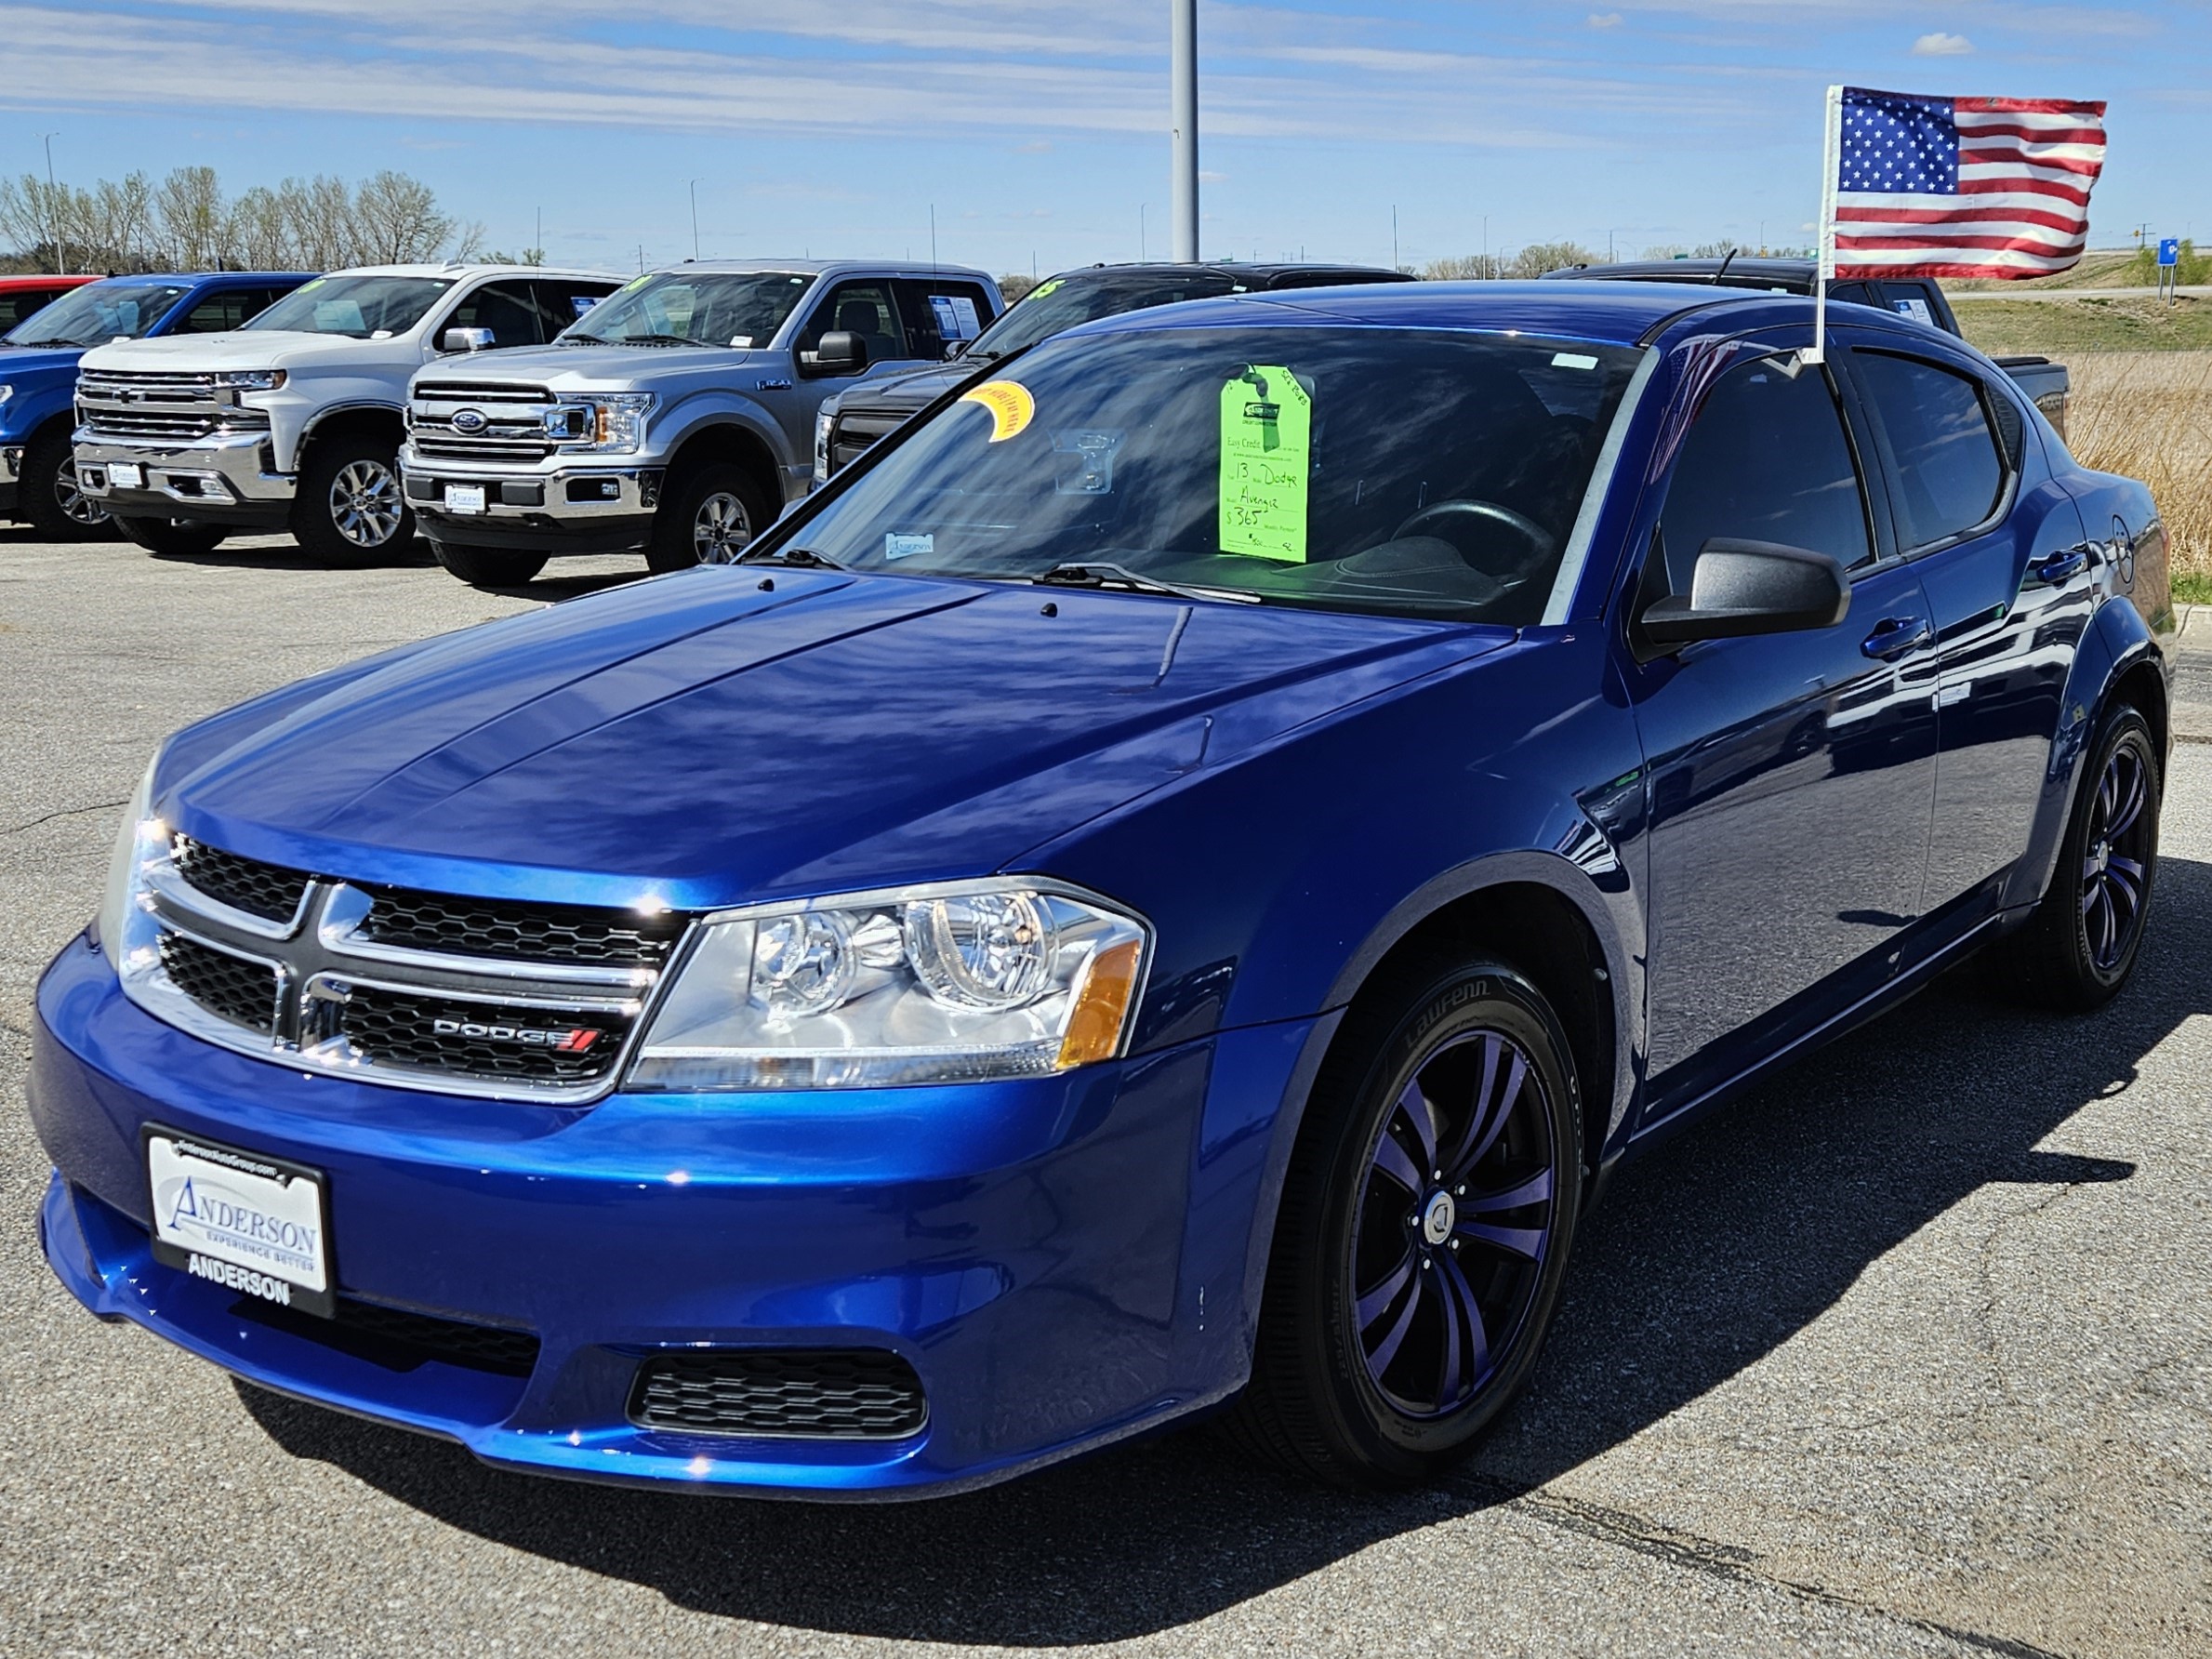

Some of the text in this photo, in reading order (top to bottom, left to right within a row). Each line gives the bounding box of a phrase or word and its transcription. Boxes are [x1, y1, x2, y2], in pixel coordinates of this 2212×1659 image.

[1227, 437, 1261, 449] Easy Credit
[1237, 462, 1249, 479] 13
[433, 1018, 575, 1047] DODGE
[178, 1139, 278, 1176] AndersonAutoGroup.com
[167, 1175, 317, 1254] ANDERSON
[206, 1231, 315, 1272] EXPERIENCE BETTER
[189, 1253, 291, 1306] ANDERSON
